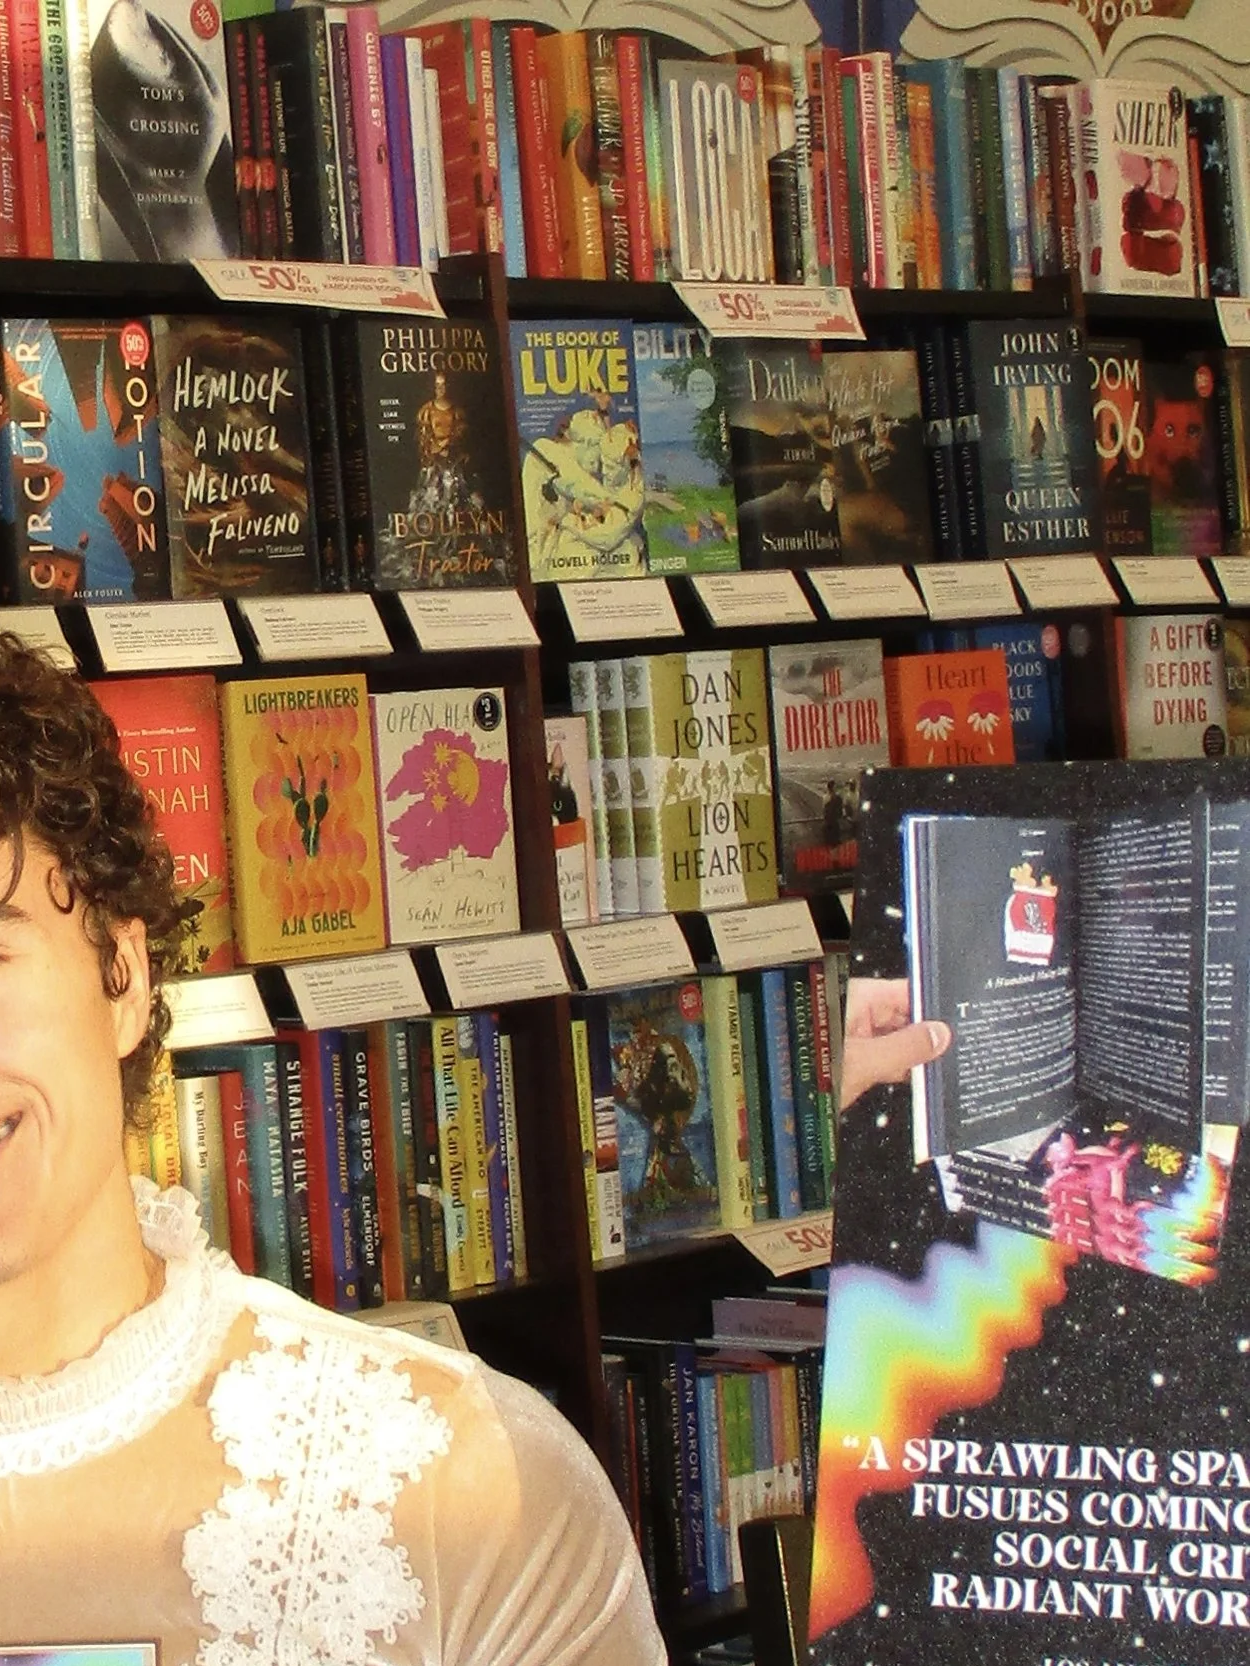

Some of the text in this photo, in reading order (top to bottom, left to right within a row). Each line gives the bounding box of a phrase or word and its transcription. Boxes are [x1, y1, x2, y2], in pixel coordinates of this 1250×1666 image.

[141, 86, 185, 101] TOM'S
[129, 118, 200, 137] CROSSING
[382, 328, 485, 350] PHILIPPA
[526, 331, 618, 346] THE BOOK OF
[1000, 335, 1058, 355] JOHN
[380, 351, 489, 373] GREGORY
[521, 348, 629, 395] LUKE
[993, 364, 1072, 386] IRVING
[174, 357, 293, 412] HEMLOCK
[15, 342, 54, 590] CIRCULAR
[1006, 490, 1081, 512] QUEEN
[394, 510, 504, 538] BOLEYN
[1004, 519, 1091, 542] ESTHER
[1150, 624, 1205, 651] A GIFT
[822, 667, 843, 698] THE
[925, 664, 986, 691] Heart
[1146, 656, 1212, 688] BEFORE
[244, 687, 359, 715] LIGHTBREAKERS
[681, 670, 741, 706] DAN
[784, 697, 881, 753] DIRECTOR
[1154, 695, 1207, 726] DYING
[671, 713, 757, 759] JONES
[688, 800, 749, 838] LION
[673, 841, 768, 882] HEARTS
[281, 911, 356, 936] AJA GABEL
[286, 1061, 308, 1194] STRANGE FOLK
[356, 1052, 373, 1172] GRAVE BIRDS
[902, 1439, 1158, 1482] SPRAWLING
[912, 1483, 1069, 1522] FUSUES
[994, 1533, 1157, 1575] SOCIAL
[931, 1573, 1131, 1619] RADIANT
